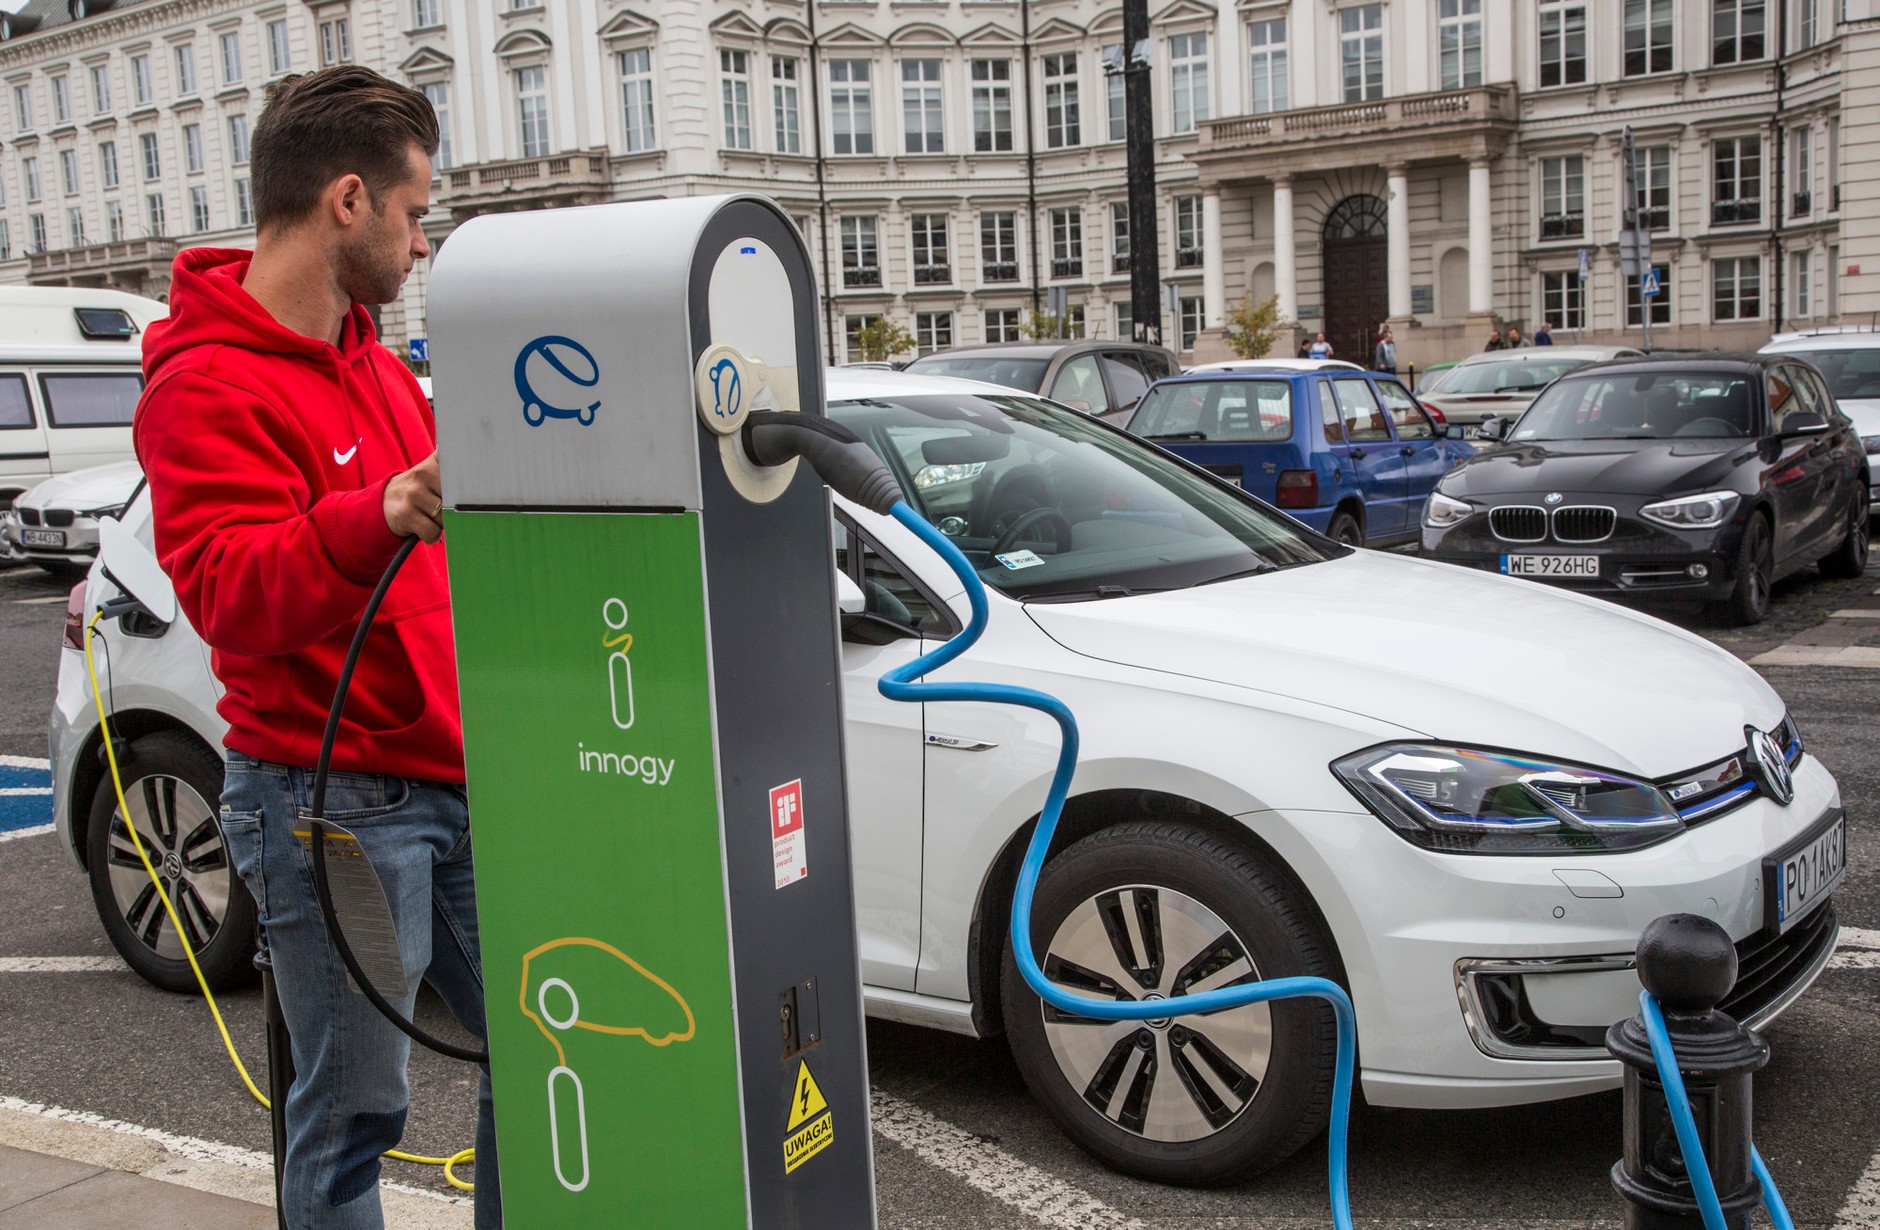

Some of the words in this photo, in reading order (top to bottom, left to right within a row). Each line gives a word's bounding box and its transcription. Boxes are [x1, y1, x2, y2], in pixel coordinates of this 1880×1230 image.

[1511, 556, 1535, 573] WE
[1541, 557, 1597, 574] 926HG
[578, 742, 675, 786] innogy
[775, 834, 795, 848] product
[775, 846, 793, 858] design
[776, 855, 793, 868] award
[1786, 854, 1807, 913] PO
[1811, 821, 1842, 892] 1AK87
[786, 1115, 832, 1157] UWAGA!
